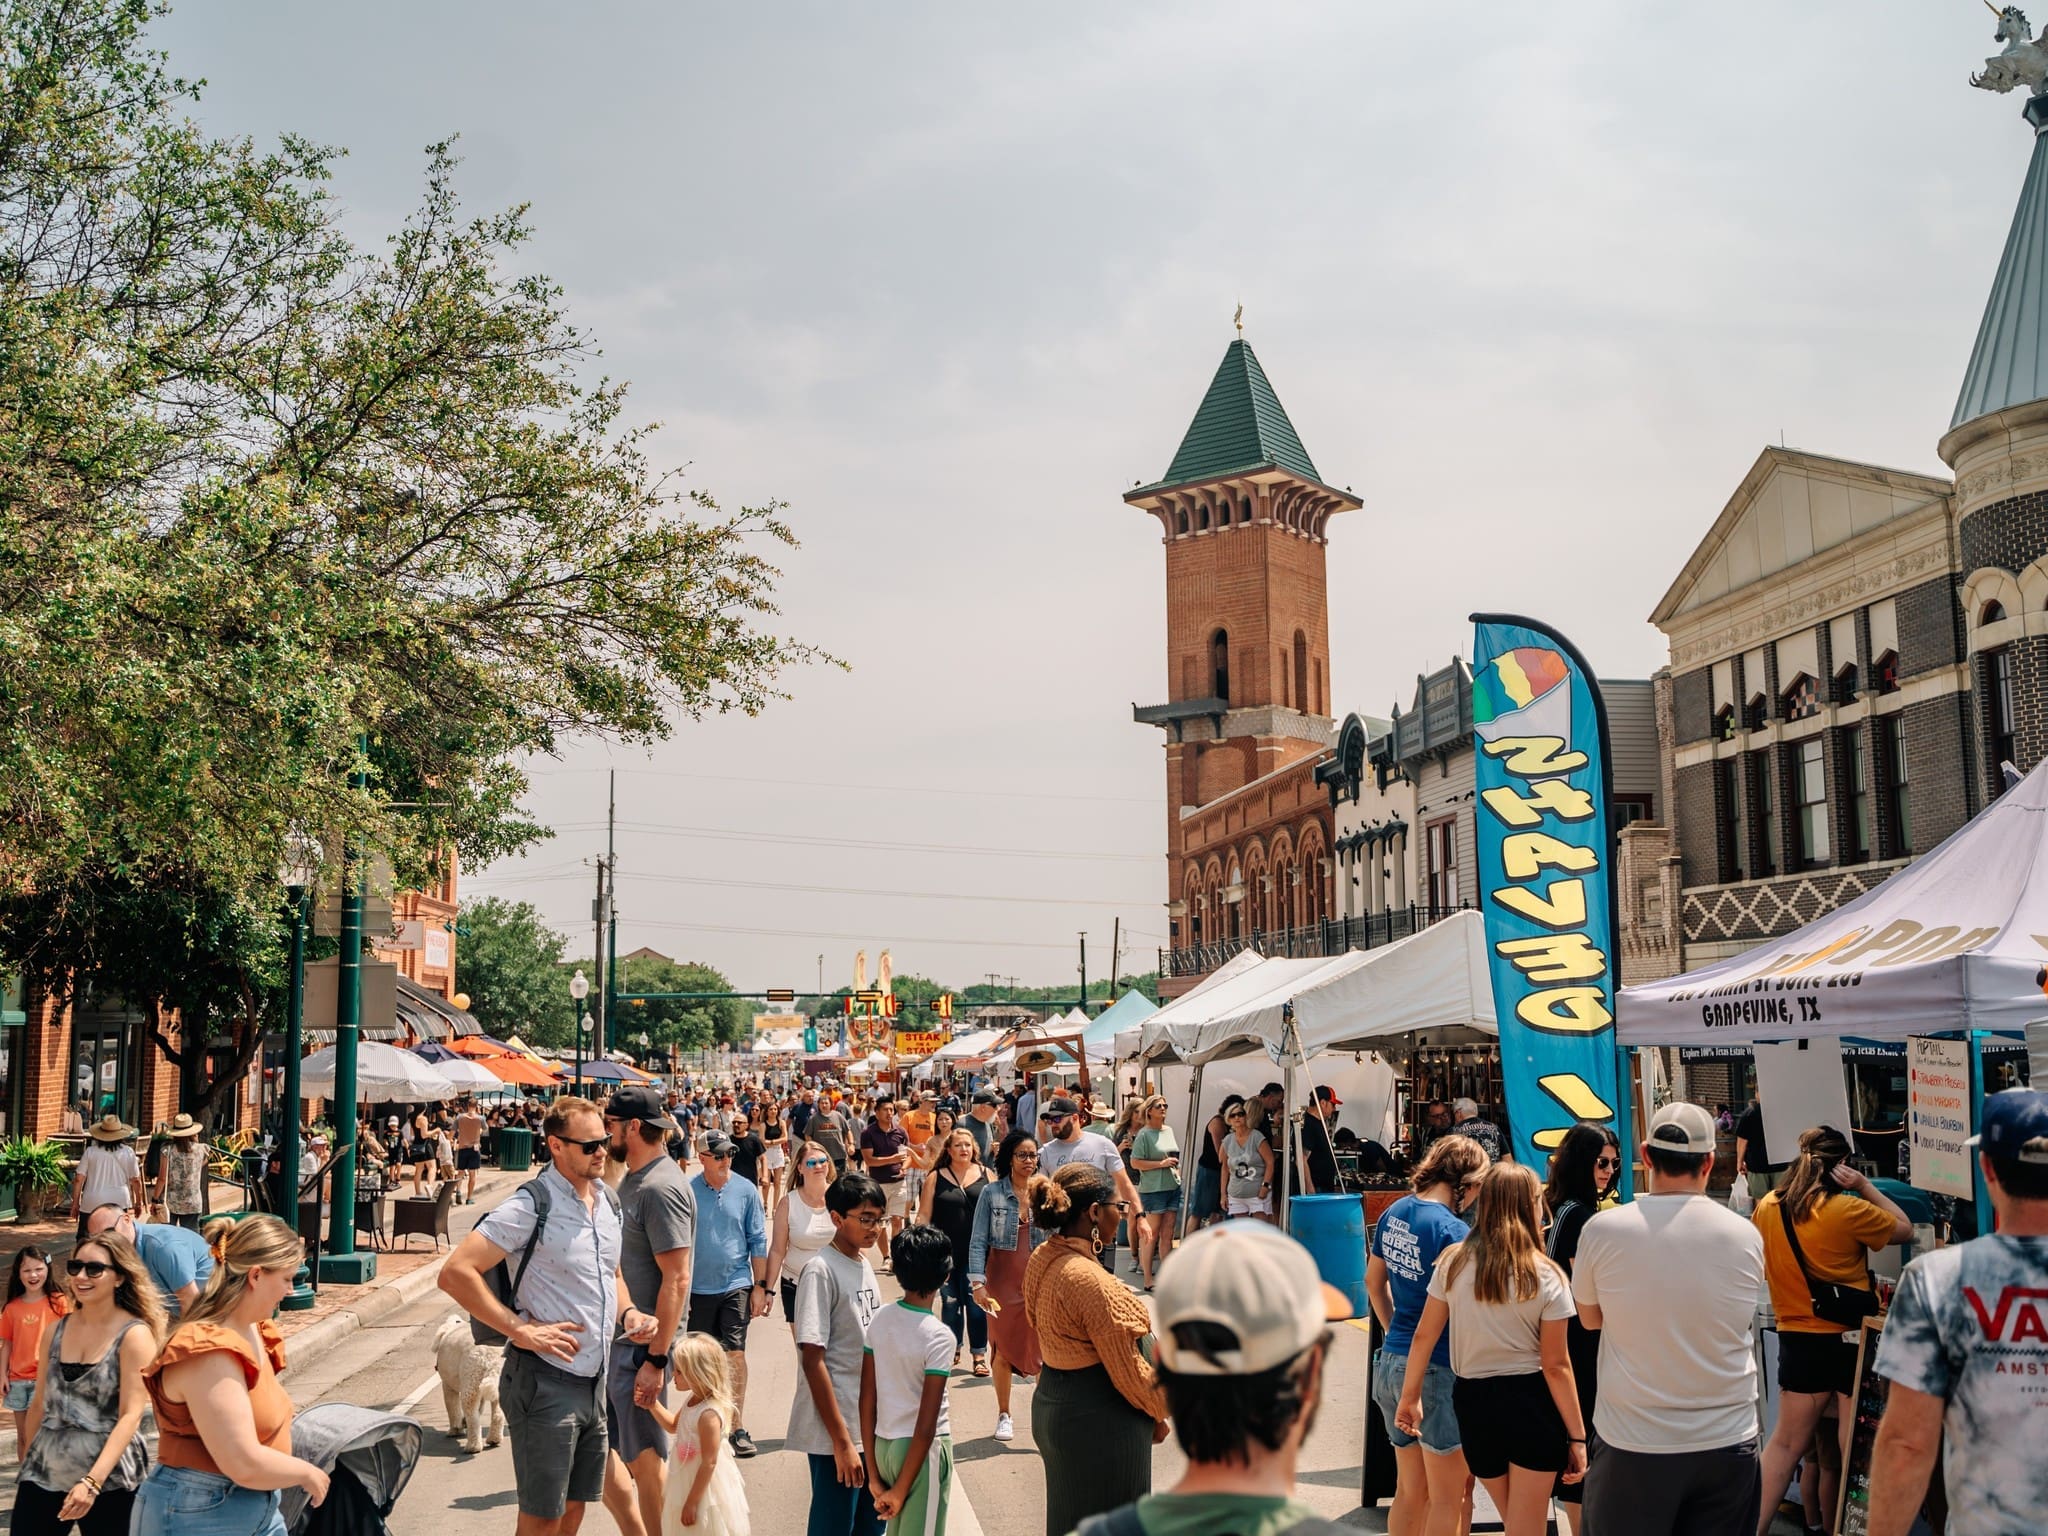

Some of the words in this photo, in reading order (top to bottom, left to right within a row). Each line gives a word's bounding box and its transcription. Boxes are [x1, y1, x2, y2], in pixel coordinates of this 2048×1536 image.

[1702, 997, 1794, 1027] GRAPEVINE,
[1797, 996, 1822, 1022] TX
[905, 1033, 940, 1041] STEAK
[1682, 1048, 1700, 1060] Explore
[1700, 1047, 1714, 1057] 100%
[1715, 1047, 1729, 1056] Texas
[1730, 1047, 1746, 1056] Estate
[1918, 1112, 1939, 1130] VANILLA
[1940, 1116, 1964, 1133] BOURBON
[1936, 1138, 1963, 1156] LEMONADE
[1382, 1231, 1420, 1258] BOBCAT
[1382, 1244, 1421, 1271] SOCCER
